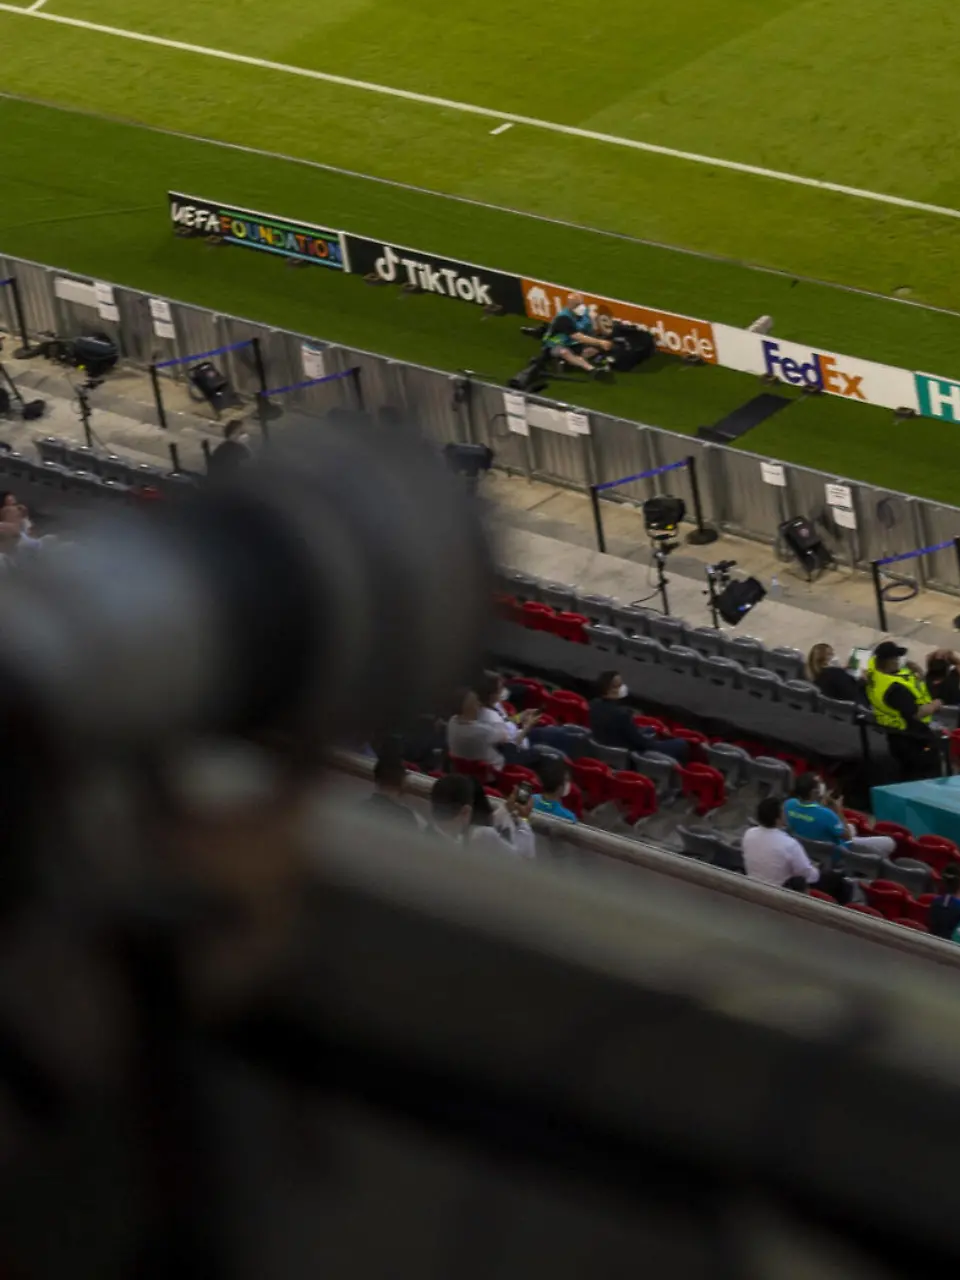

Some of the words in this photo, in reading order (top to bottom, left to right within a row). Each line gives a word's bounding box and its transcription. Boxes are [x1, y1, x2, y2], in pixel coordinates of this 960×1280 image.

[171, 201, 220, 234] UEFA
[219, 213, 342, 263] FOUNDATION
[402, 257, 493, 305] TikTok
[762, 340, 868, 400] FedEx
